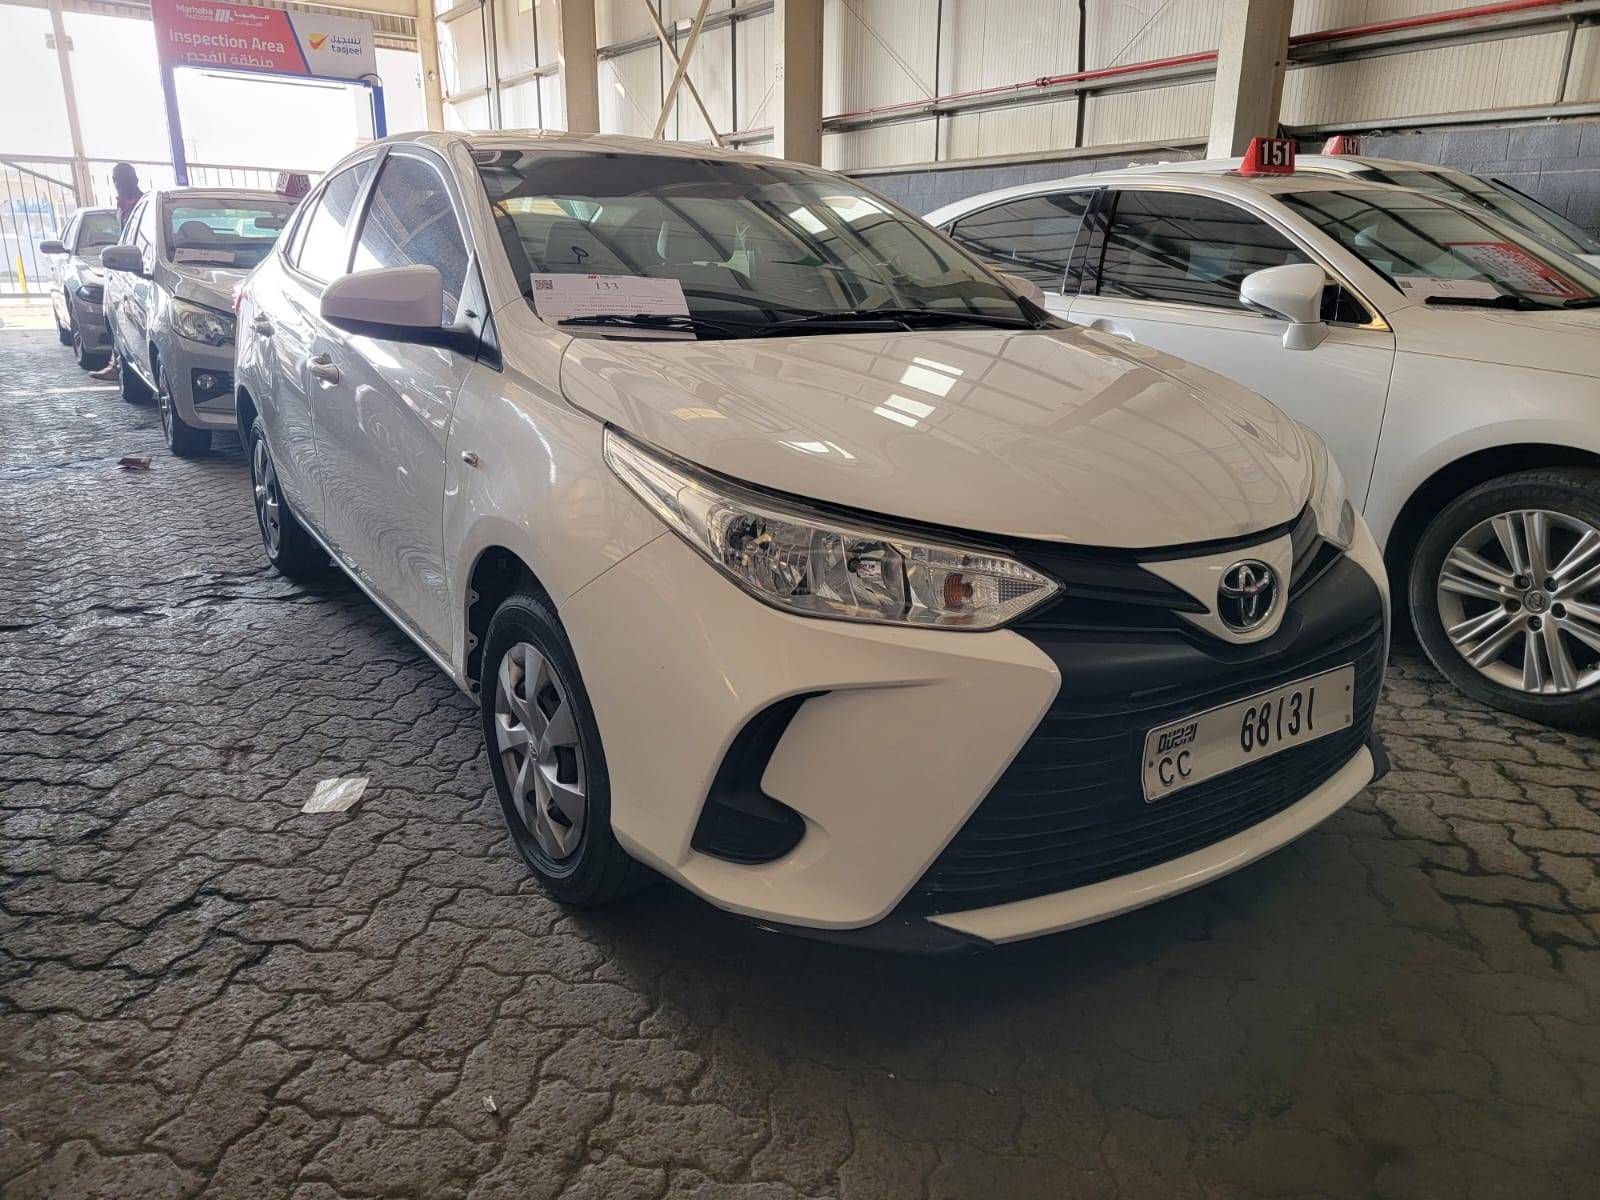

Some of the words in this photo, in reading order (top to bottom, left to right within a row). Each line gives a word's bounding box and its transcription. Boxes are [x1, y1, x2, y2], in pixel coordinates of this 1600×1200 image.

[169, 28, 248, 49] Inspection
[251, 37, 285, 53] Area
[331, 44, 362, 56] tasjeel
[230, 51, 274, 69] منطقة
[1262, 141, 1290, 166] 151
[1240, 687, 1315, 752] 68131
[1159, 750, 1192, 785] CC
